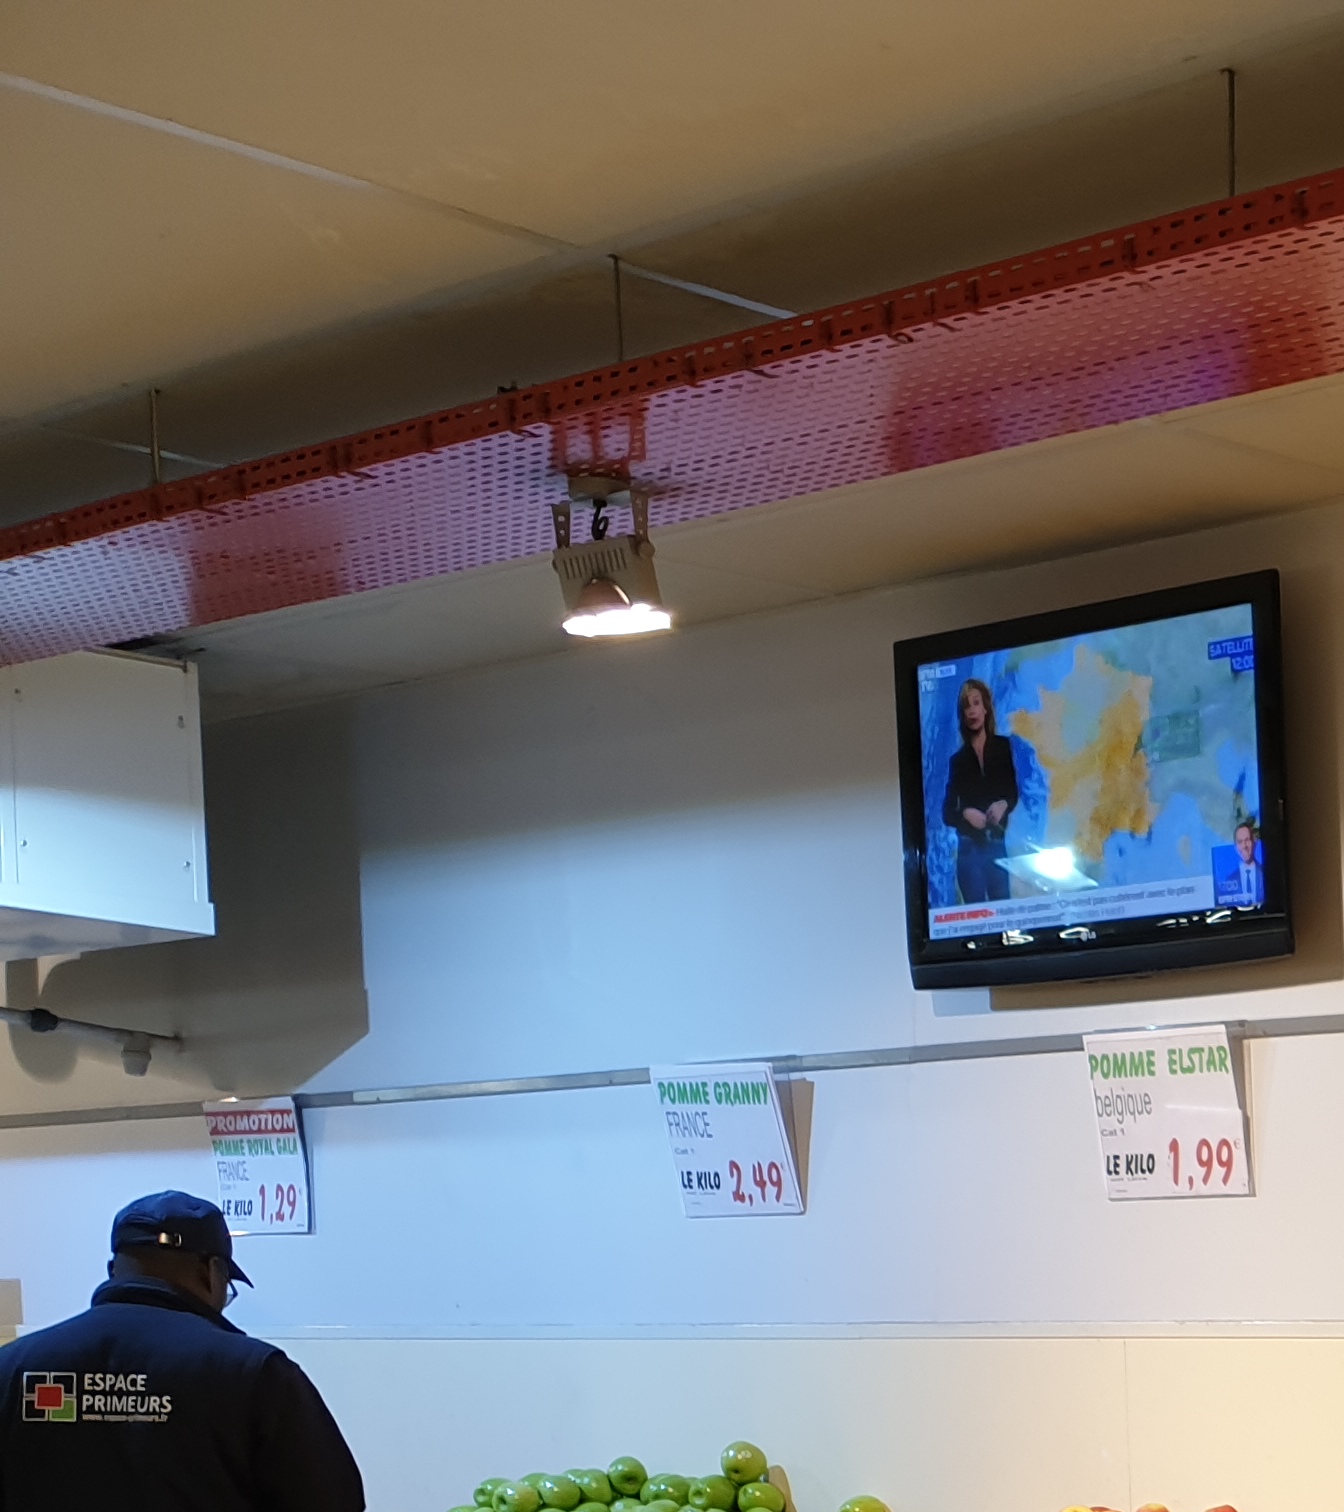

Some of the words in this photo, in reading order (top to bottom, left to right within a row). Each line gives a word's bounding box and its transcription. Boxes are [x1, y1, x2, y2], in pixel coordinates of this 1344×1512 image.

[1088, 1050, 1156, 1080] POMME
[1167, 1045, 1229, 1075] ELSTAR
[657, 1081, 710, 1105] POMME
[713, 1081, 768, 1107] GRANNY
[1094, 1087, 1152, 1124] belgique
[206, 1113, 295, 1132] PROMOTION
[665, 1111, 713, 1138] FRANCE
[213, 1139, 246, 1157] POMME
[1106, 1154, 1120, 1176] LE
[1125, 1153, 1155, 1177] KILO
[681, 1170, 693, 1189] LE
[696, 1171, 721, 1191] KILO
[234, 1199, 253, 1216] KILO
[83, 1373, 148, 1391] ESPACE
[82, 1394, 173, 1414] PRIMEURS
